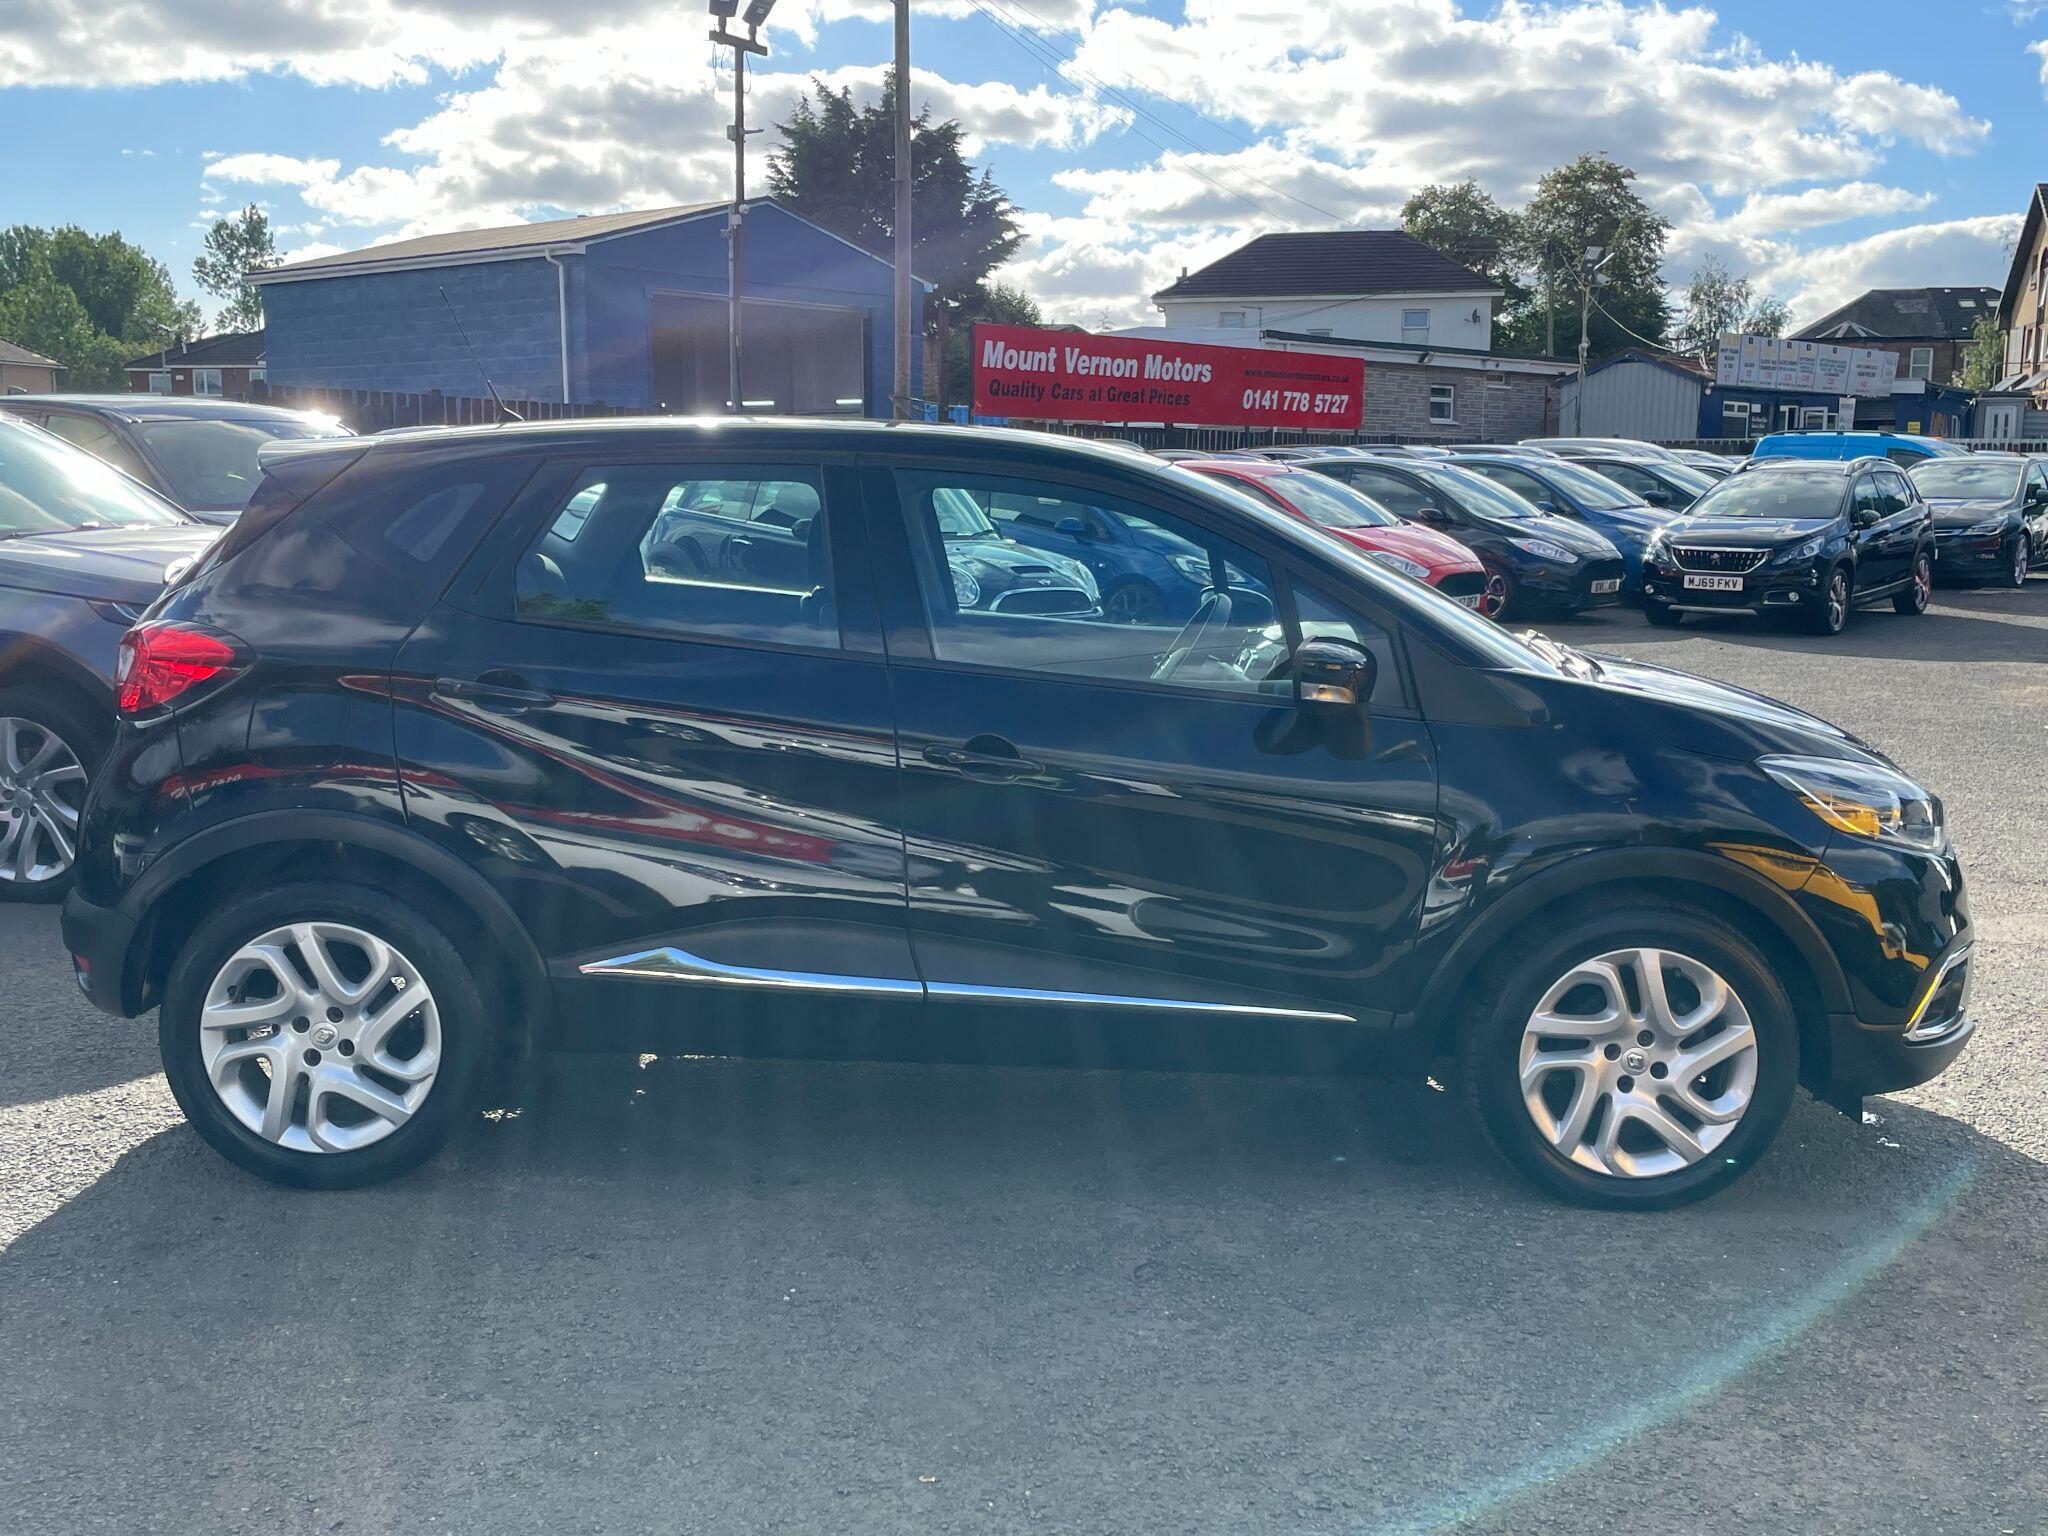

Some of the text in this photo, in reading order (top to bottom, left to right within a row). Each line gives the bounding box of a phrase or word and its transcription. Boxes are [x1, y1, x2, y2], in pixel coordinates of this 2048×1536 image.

[982, 340, 1212, 383] Mount Vernon Motors
[989, 379, 1190, 406] Quality Cars at Great Prices
[1242, 388, 1349, 414] 0141 778 5727
[1688, 577, 1738, 589] MJ69 FKV
